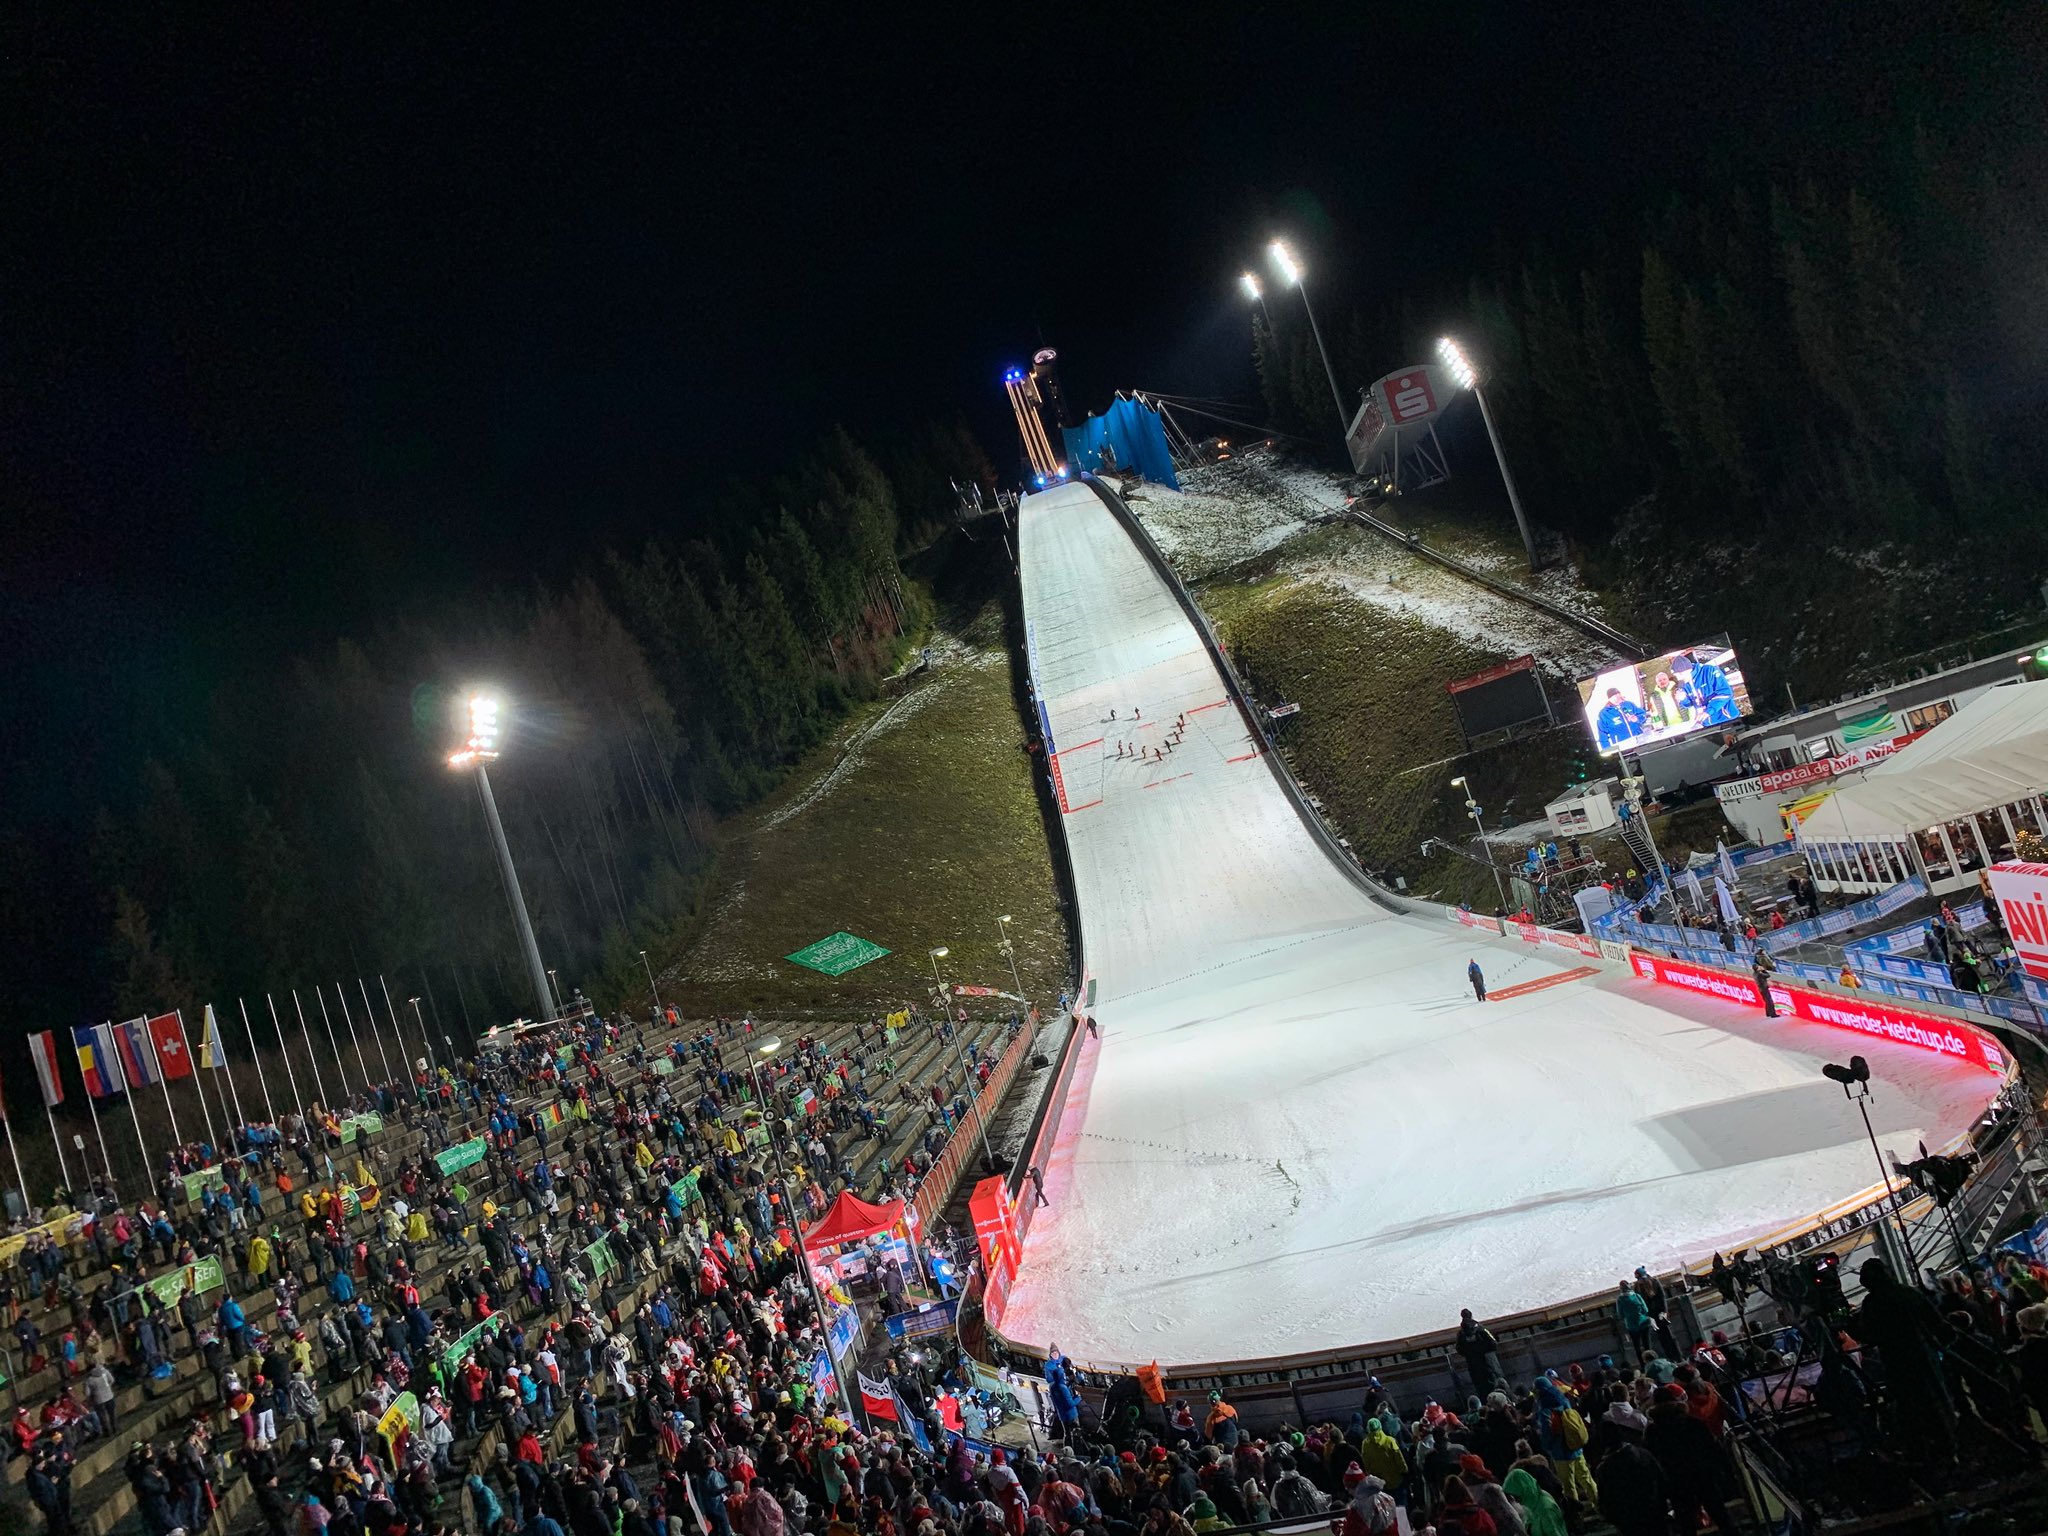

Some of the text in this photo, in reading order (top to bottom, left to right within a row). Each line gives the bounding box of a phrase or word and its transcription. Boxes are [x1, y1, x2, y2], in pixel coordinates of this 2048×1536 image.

[1724, 780, 1761, 797] VELTINS
[1763, 762, 1830, 789] apotal.de
[1664, 969, 1756, 1004] www.werder-ketchup.de
[1808, 1003, 1967, 1056] www.werder-ketchup.de
[816, 1236, 835, 1245] Home
[834, 1233, 842, 1241] of
